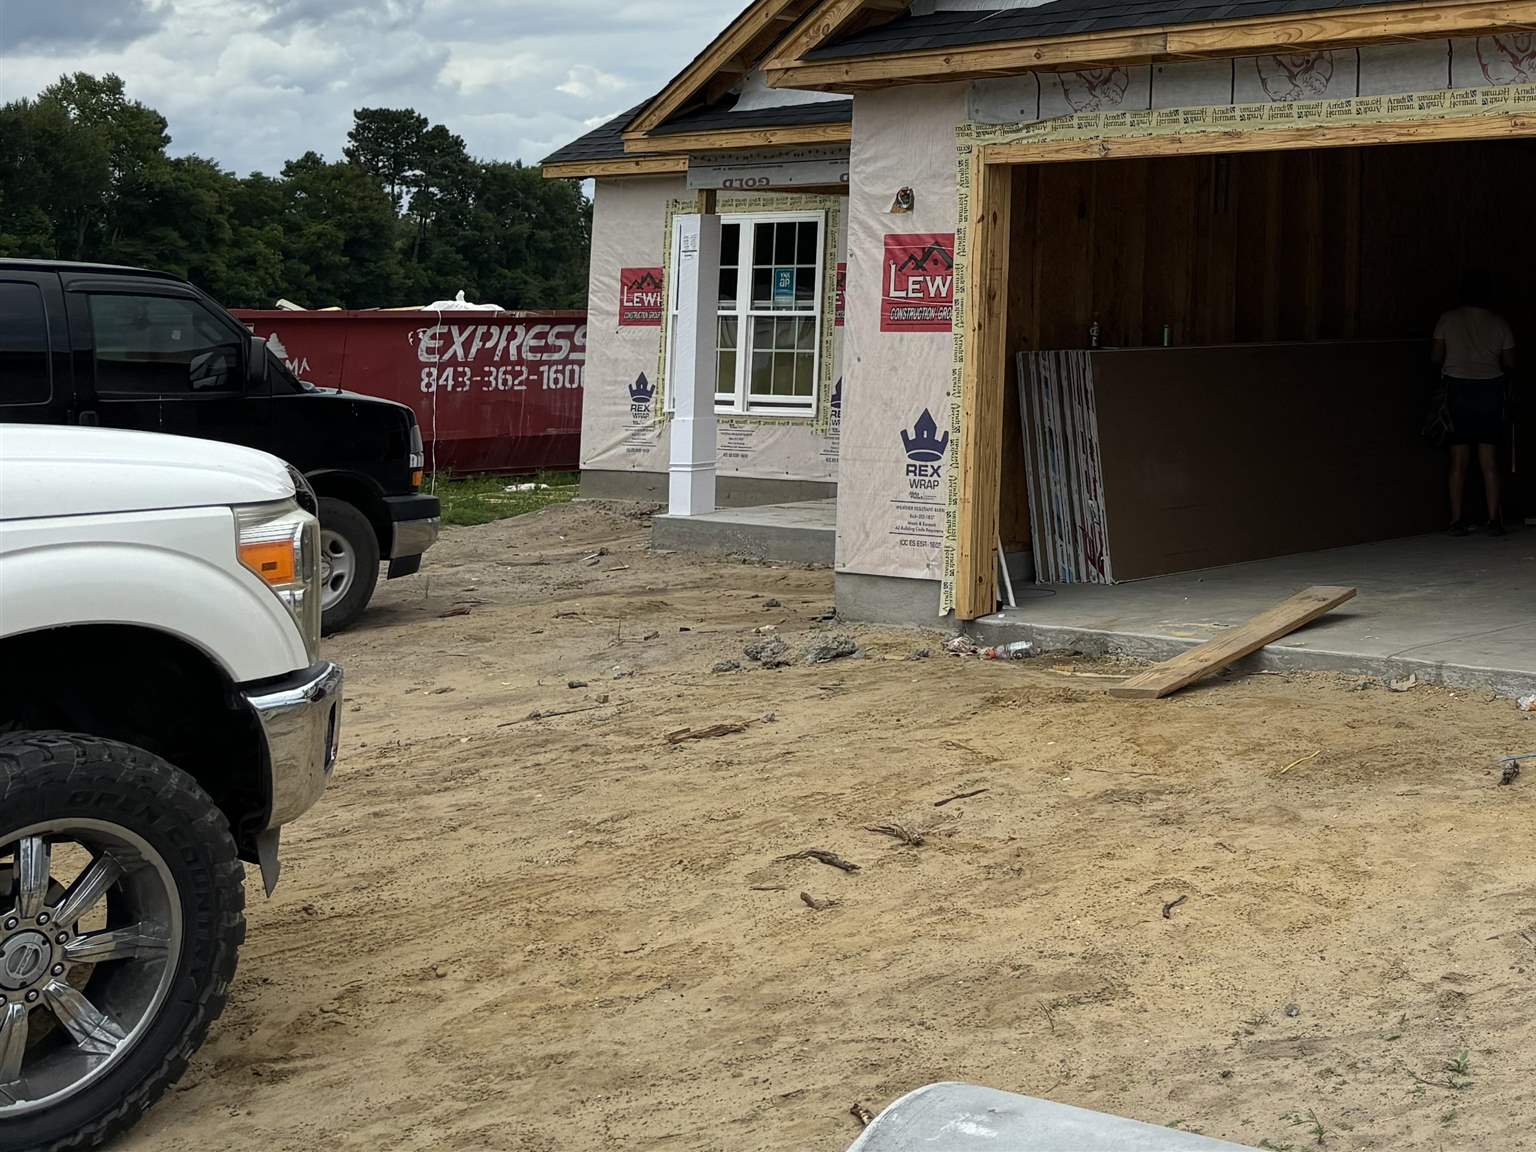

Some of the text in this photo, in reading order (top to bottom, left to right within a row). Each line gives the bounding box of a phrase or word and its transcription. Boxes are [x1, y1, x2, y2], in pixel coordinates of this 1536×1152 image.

[889, 260, 953, 298] LEW
[624, 284, 663, 308] LEWI
[421, 365, 585, 393] 843-362-160
[630, 403, 650, 413] REX
[906, 464, 942, 478] REX
[909, 479, 940, 490] WRAP
